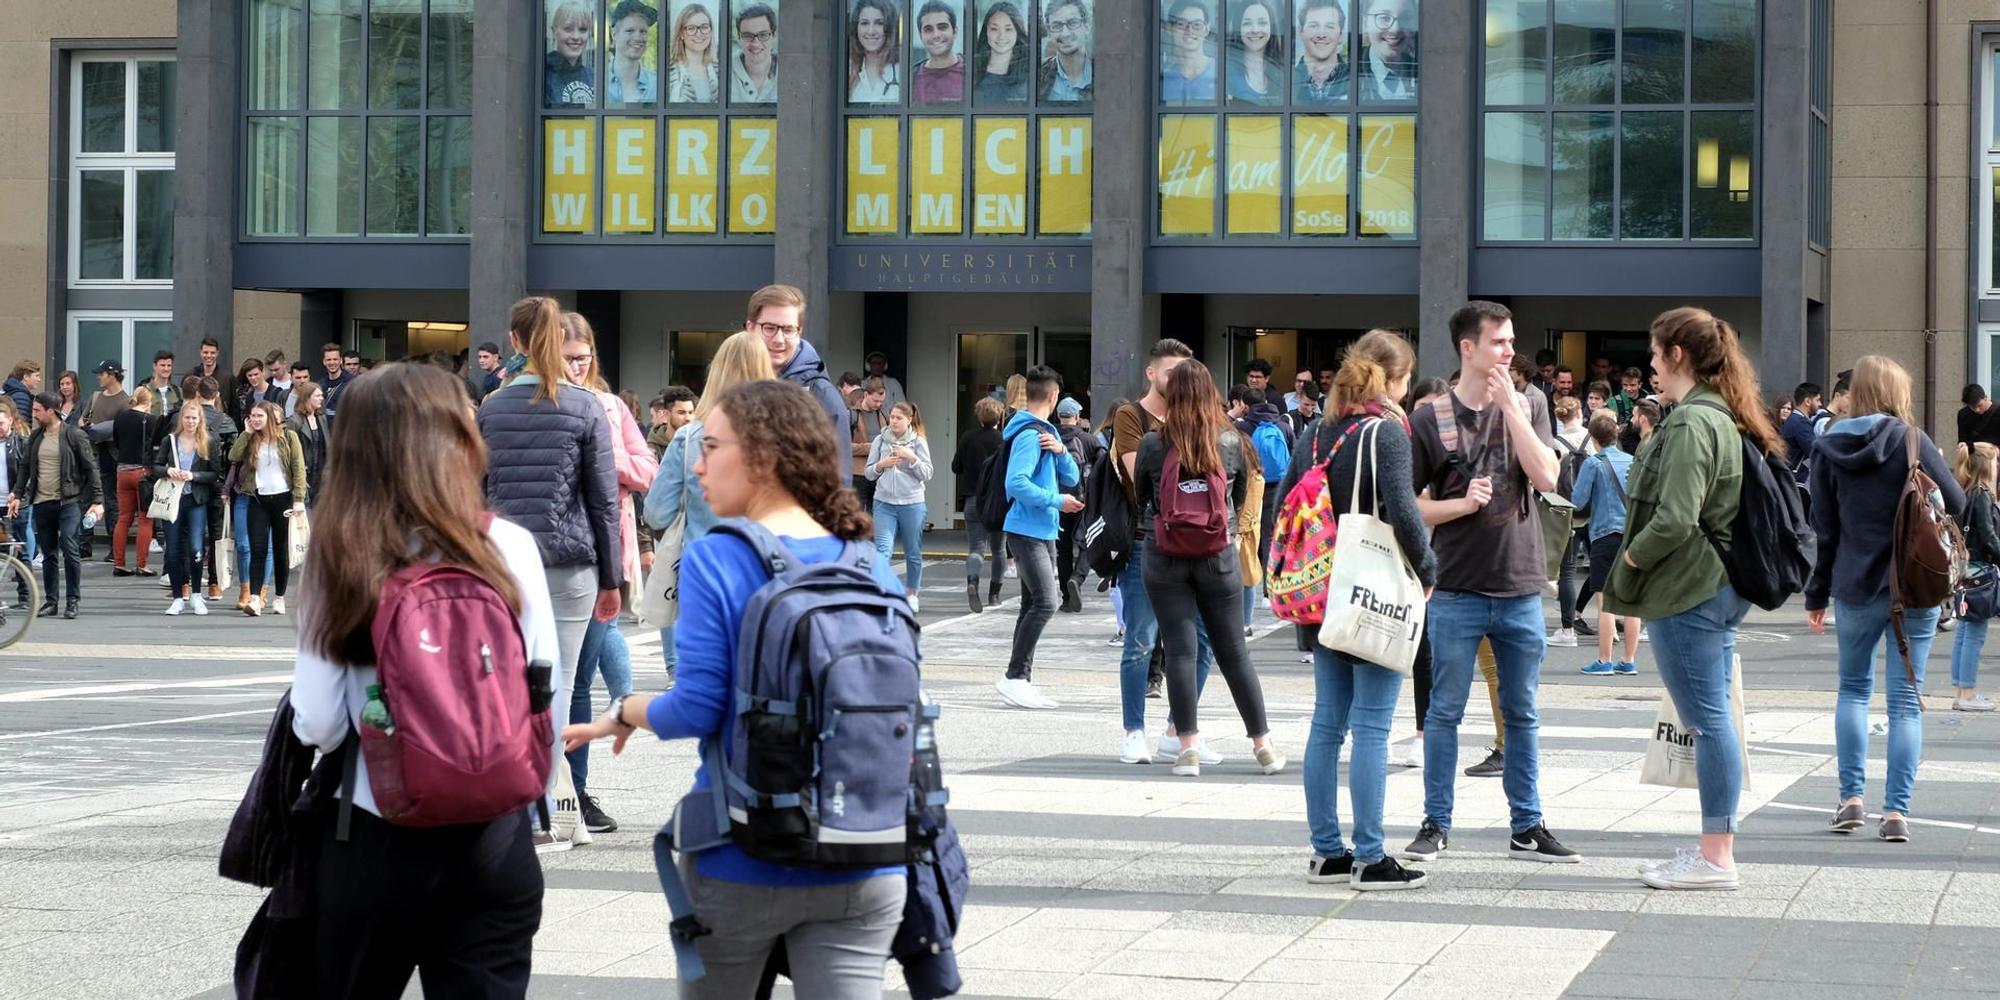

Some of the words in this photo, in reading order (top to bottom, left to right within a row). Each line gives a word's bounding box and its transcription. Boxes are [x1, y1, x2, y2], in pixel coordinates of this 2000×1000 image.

[1228, 159, 1281, 191] am
[1295, 209, 1345, 227] SoSe
[1364, 209, 1410, 227] 2018
[858, 251, 1077, 269] UNIVERSITÄT
